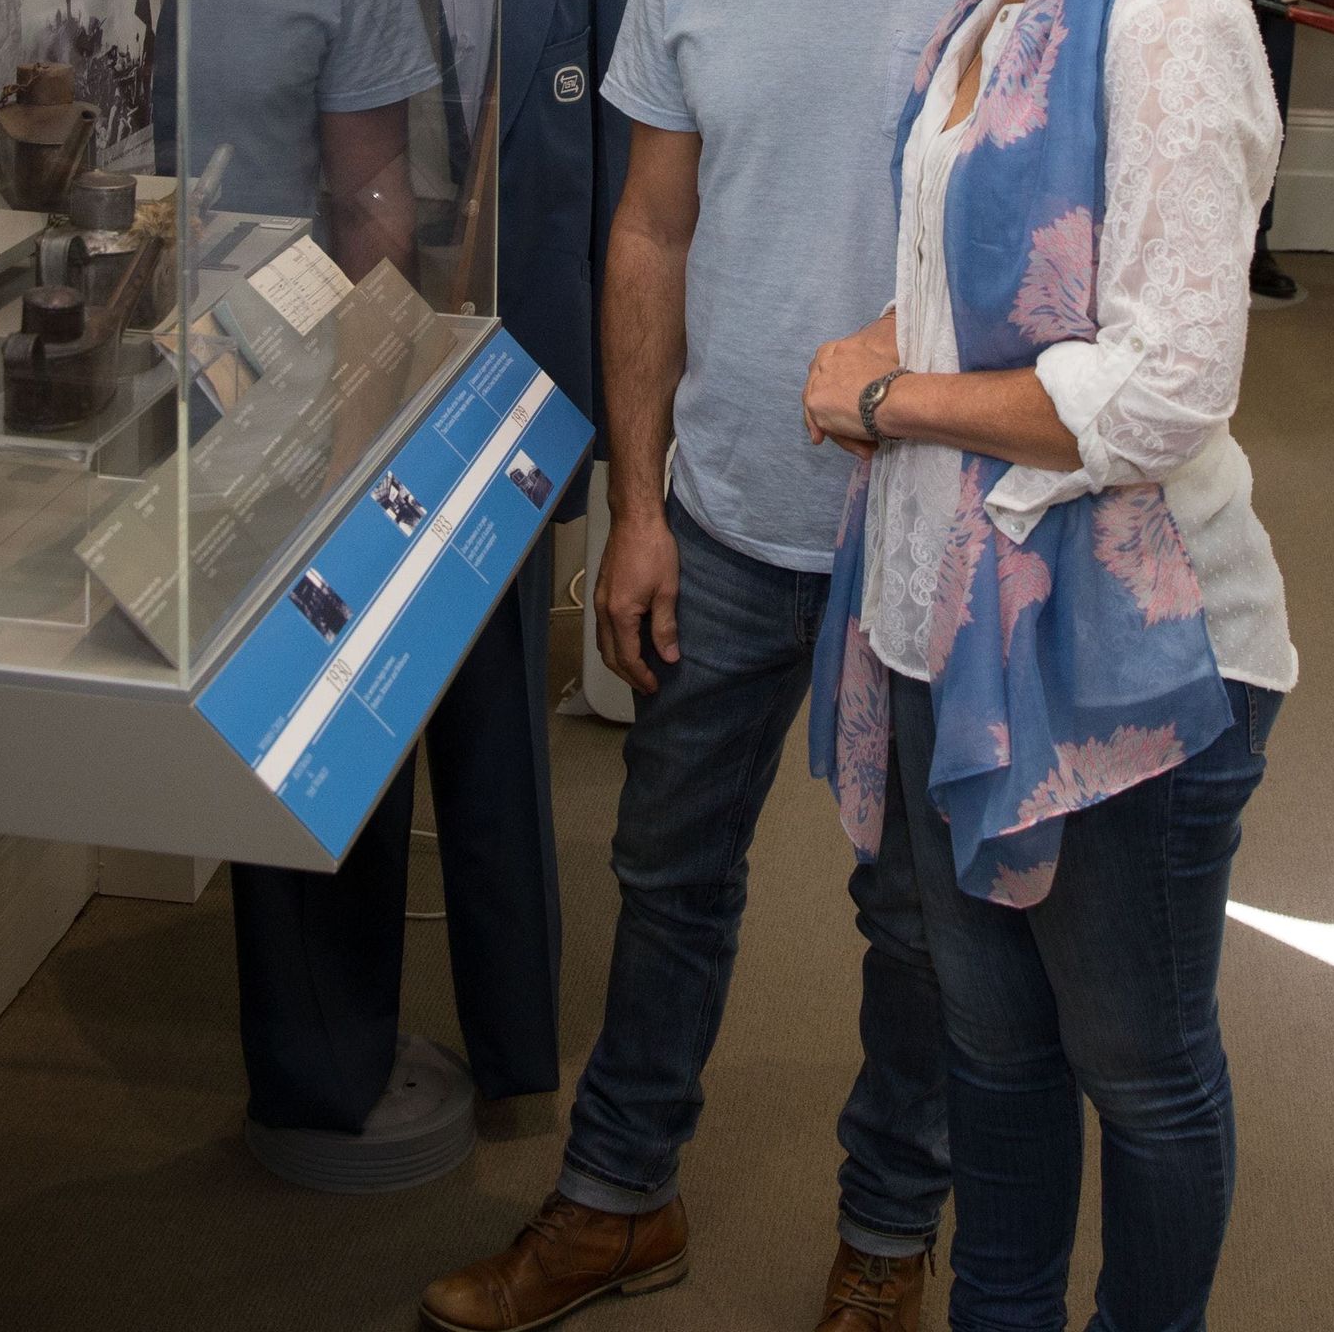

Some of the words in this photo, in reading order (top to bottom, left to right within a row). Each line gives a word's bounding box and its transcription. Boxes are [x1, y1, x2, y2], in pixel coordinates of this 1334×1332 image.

[510, 405, 530, 428] 1939
[430, 514, 453, 543] 1933
[325, 658, 353, 693] 1930
